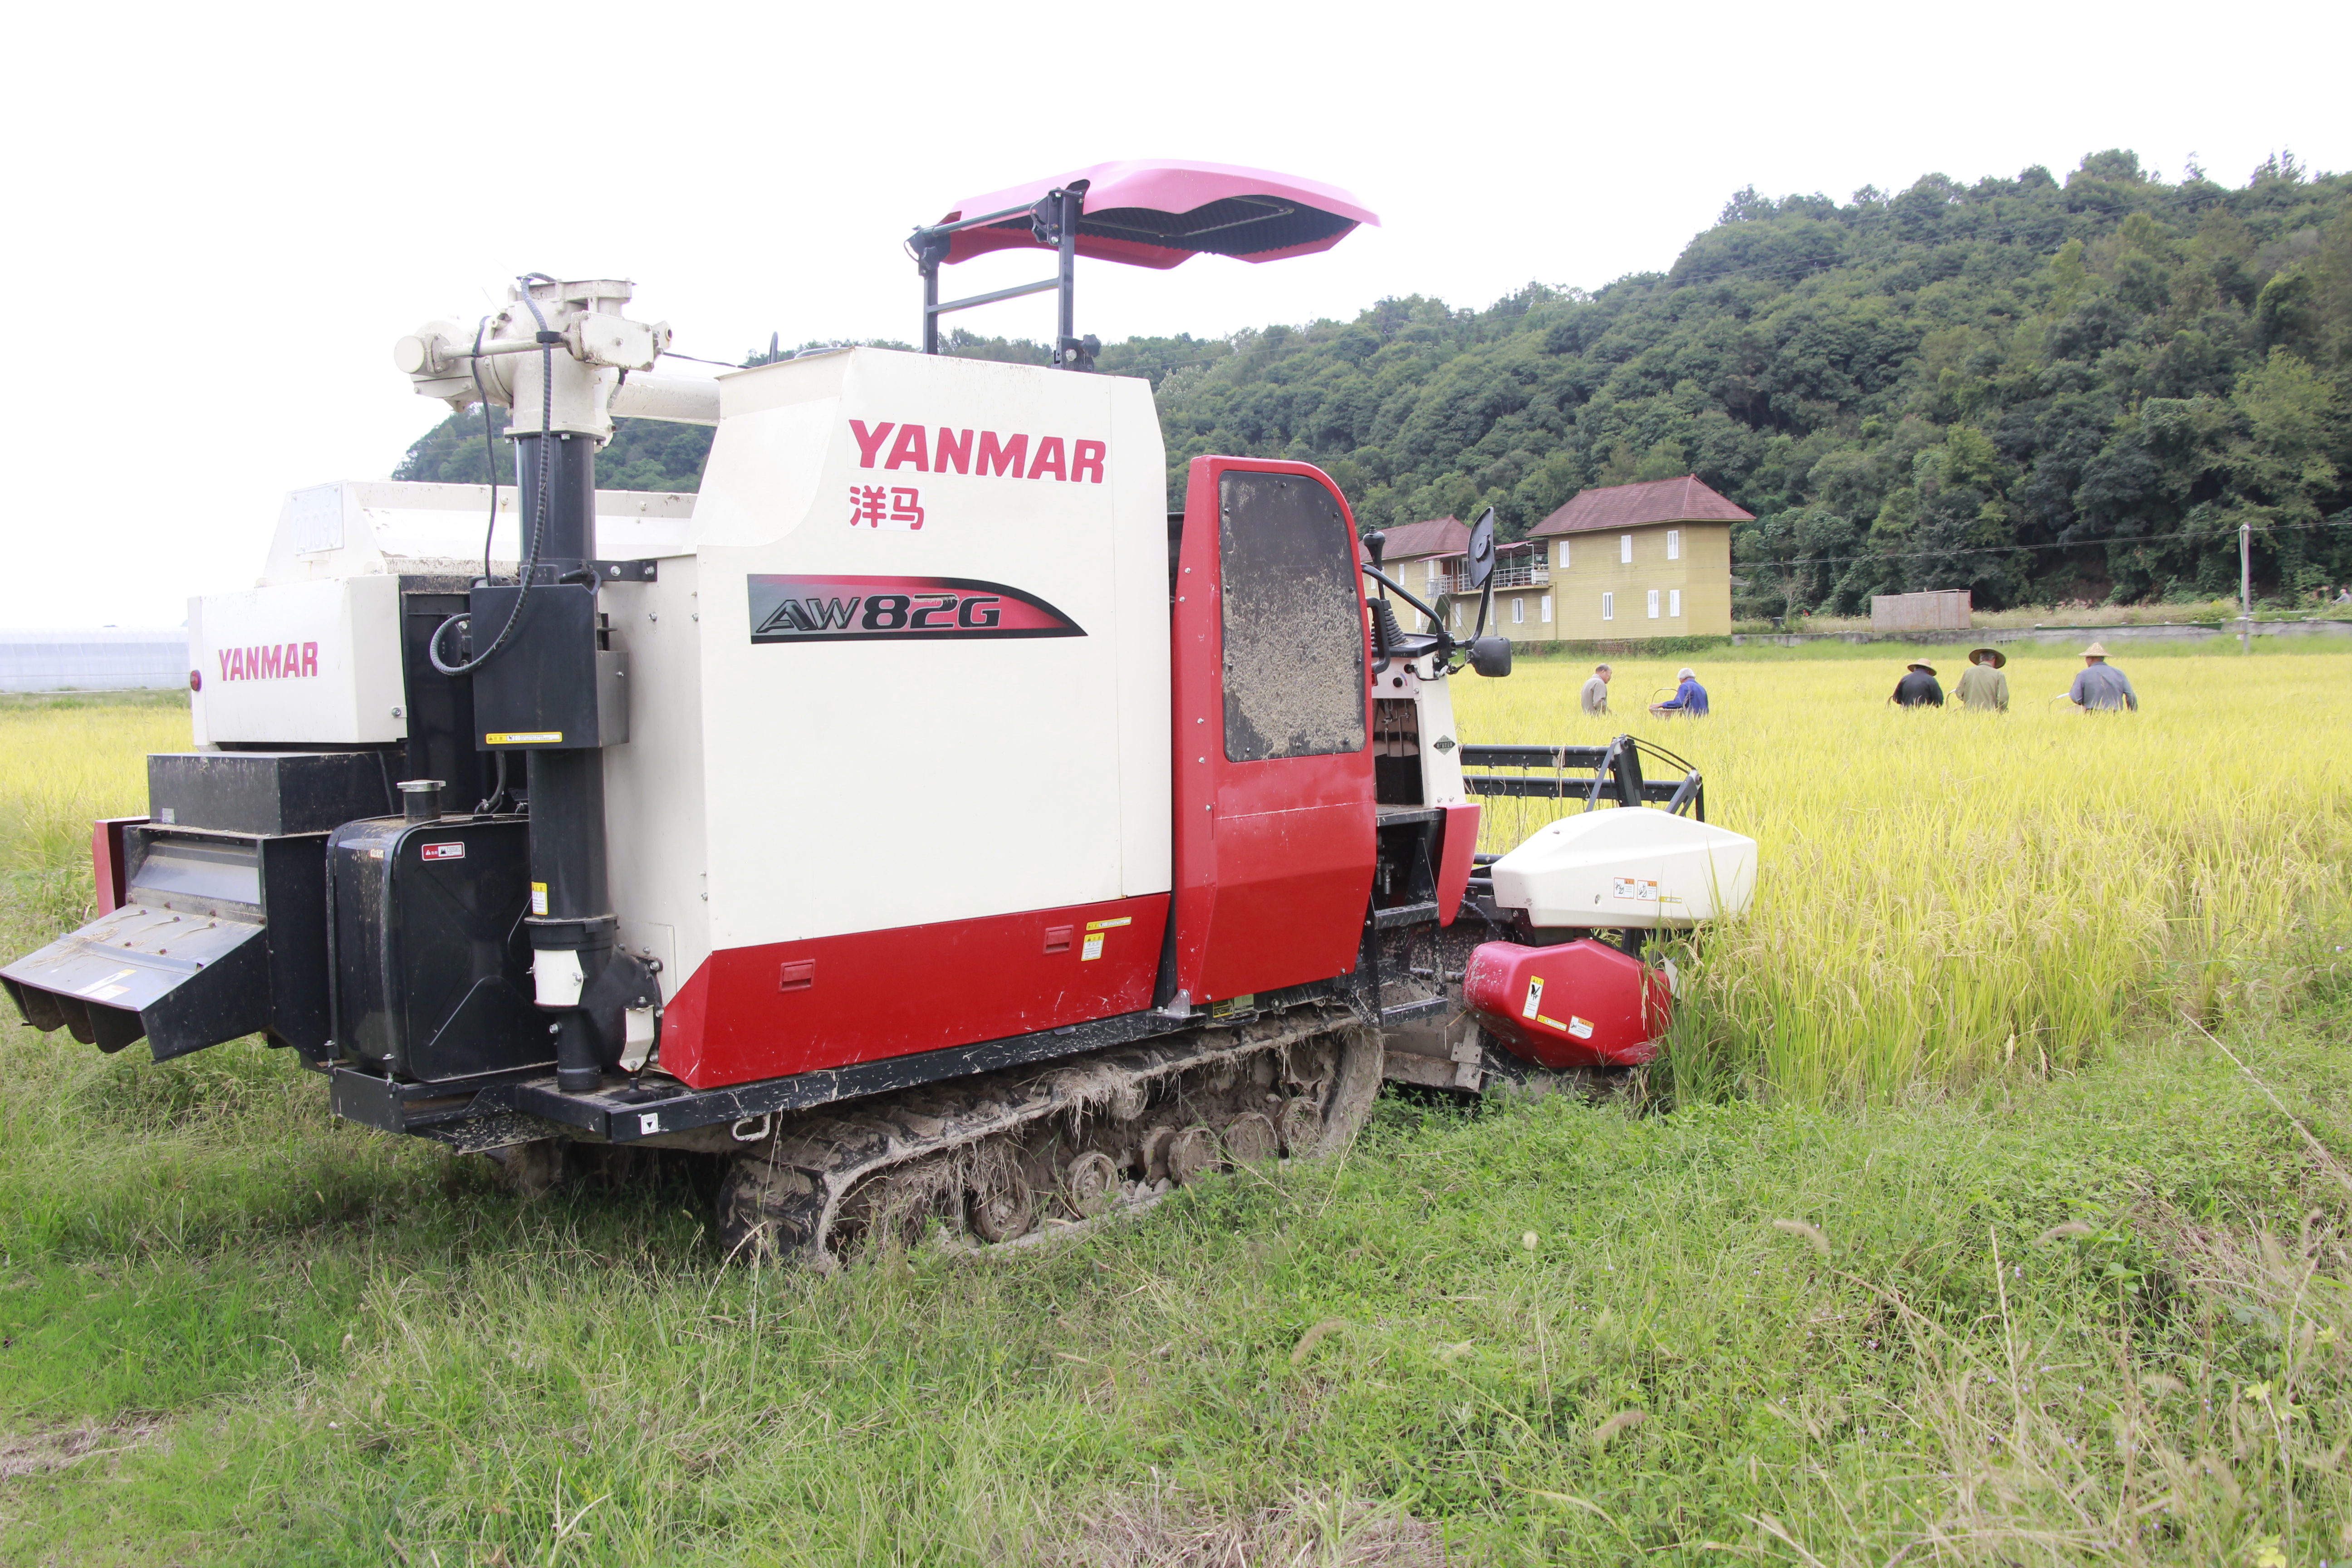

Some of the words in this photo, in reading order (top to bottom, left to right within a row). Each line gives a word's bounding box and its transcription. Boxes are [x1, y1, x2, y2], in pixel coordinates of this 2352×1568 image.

[849, 419, 1106, 484] YANMAR
[849, 485, 925, 530] 洋马
[756, 593, 1000, 632] AW82G
[219, 642, 318, 681] YANMAR
